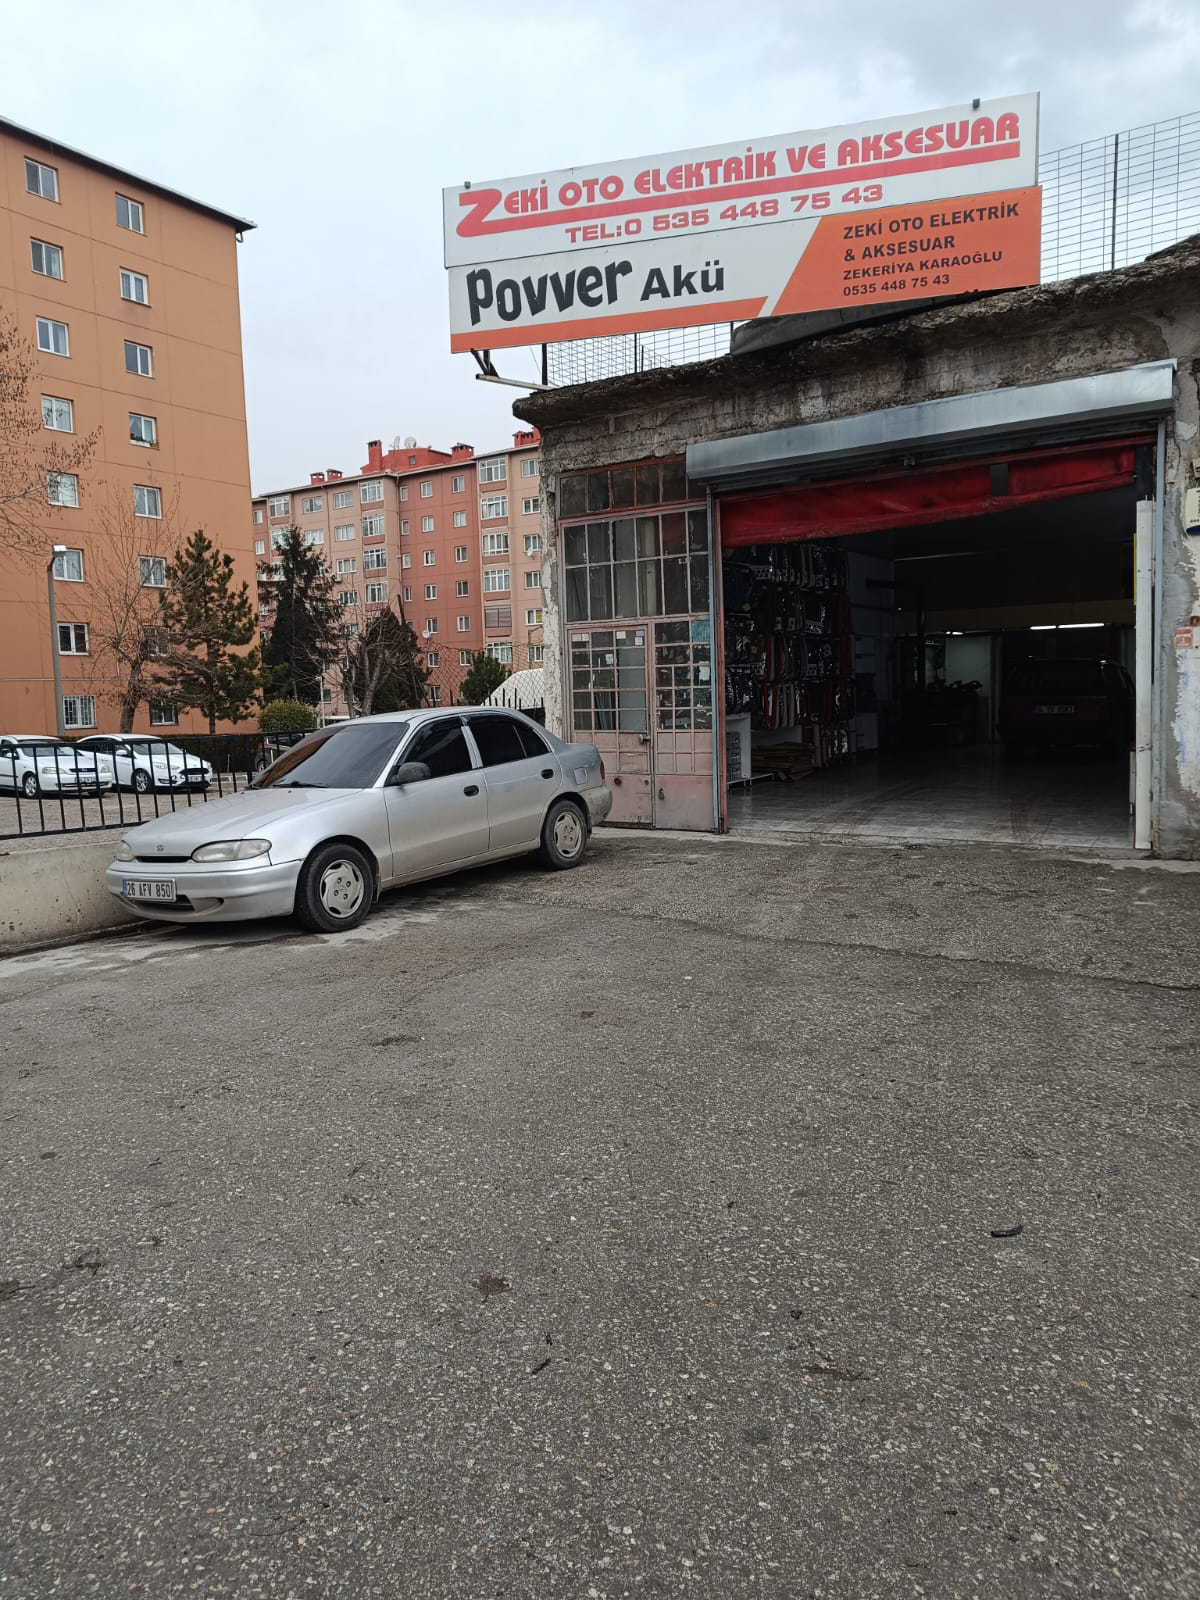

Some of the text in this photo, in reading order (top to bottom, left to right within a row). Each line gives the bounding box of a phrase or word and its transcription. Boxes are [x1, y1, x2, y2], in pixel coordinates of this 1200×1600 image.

[456, 112, 1020, 238] ZEKİ OTO ELEKTRİK VE AKSESUAR
[653, 208, 709, 231] 535
[720, 198, 779, 222] 448
[790, 191, 831, 213] 75
[841, 183, 883, 205] 43
[843, 201, 1020, 240] ZEKİ OTO ELEKTRİK
[843, 235, 956, 262] & AKSESUAR
[843, 250, 1003, 280] ZEKERİYA KARAOĞLU
[639, 259, 725, 302] Akü
[843, 273, 951, 297] 0535 448 75 43
[127, 882, 171, 898] 26 AFV 850
